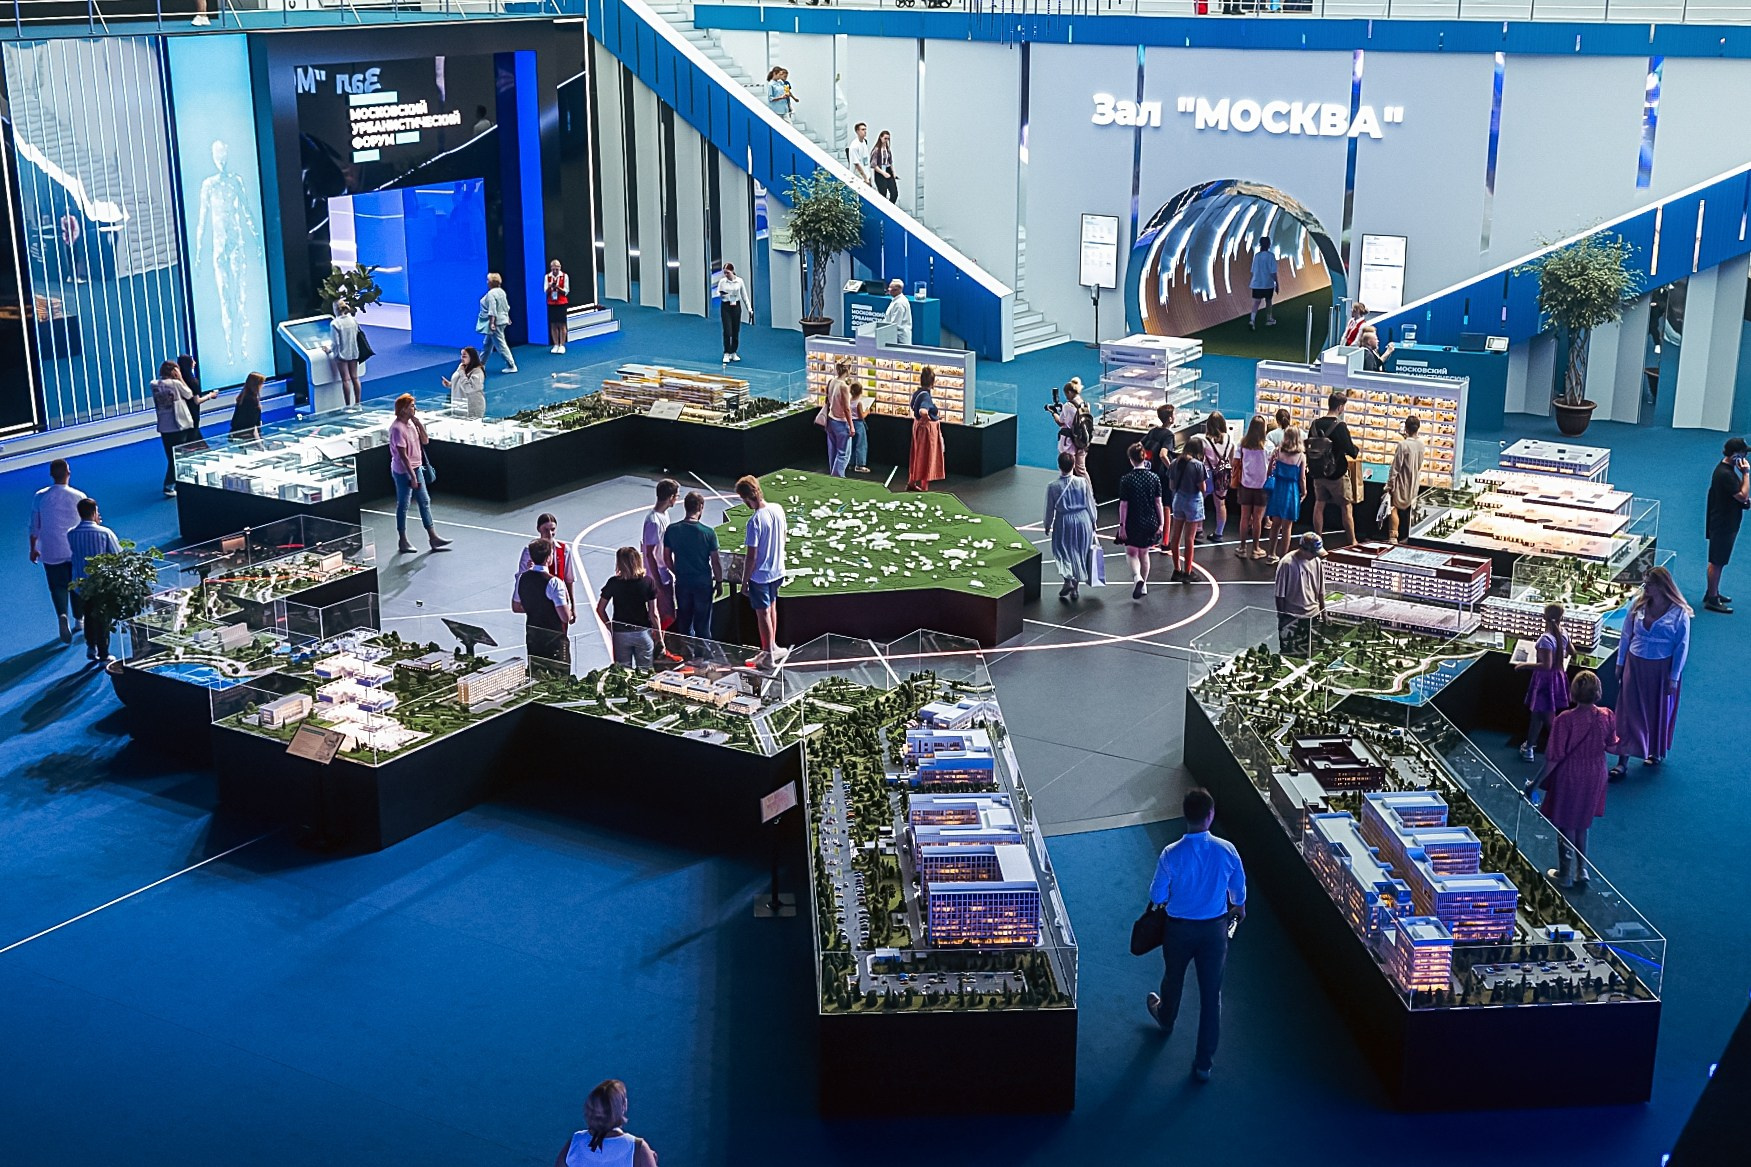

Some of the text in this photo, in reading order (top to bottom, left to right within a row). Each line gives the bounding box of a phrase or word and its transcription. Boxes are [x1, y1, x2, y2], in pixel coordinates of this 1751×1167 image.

[349, 99, 428, 121] МОСКОВСКИЙ
[1091, 93, 1405, 139] Зал "МОСКВА"
[351, 109, 461, 136] УРБАНИСТИЧЕСКИЙ
[351, 133, 396, 150] ФОРУМ
[1395, 366, 1448, 375] МОСКОВСКИЙ
